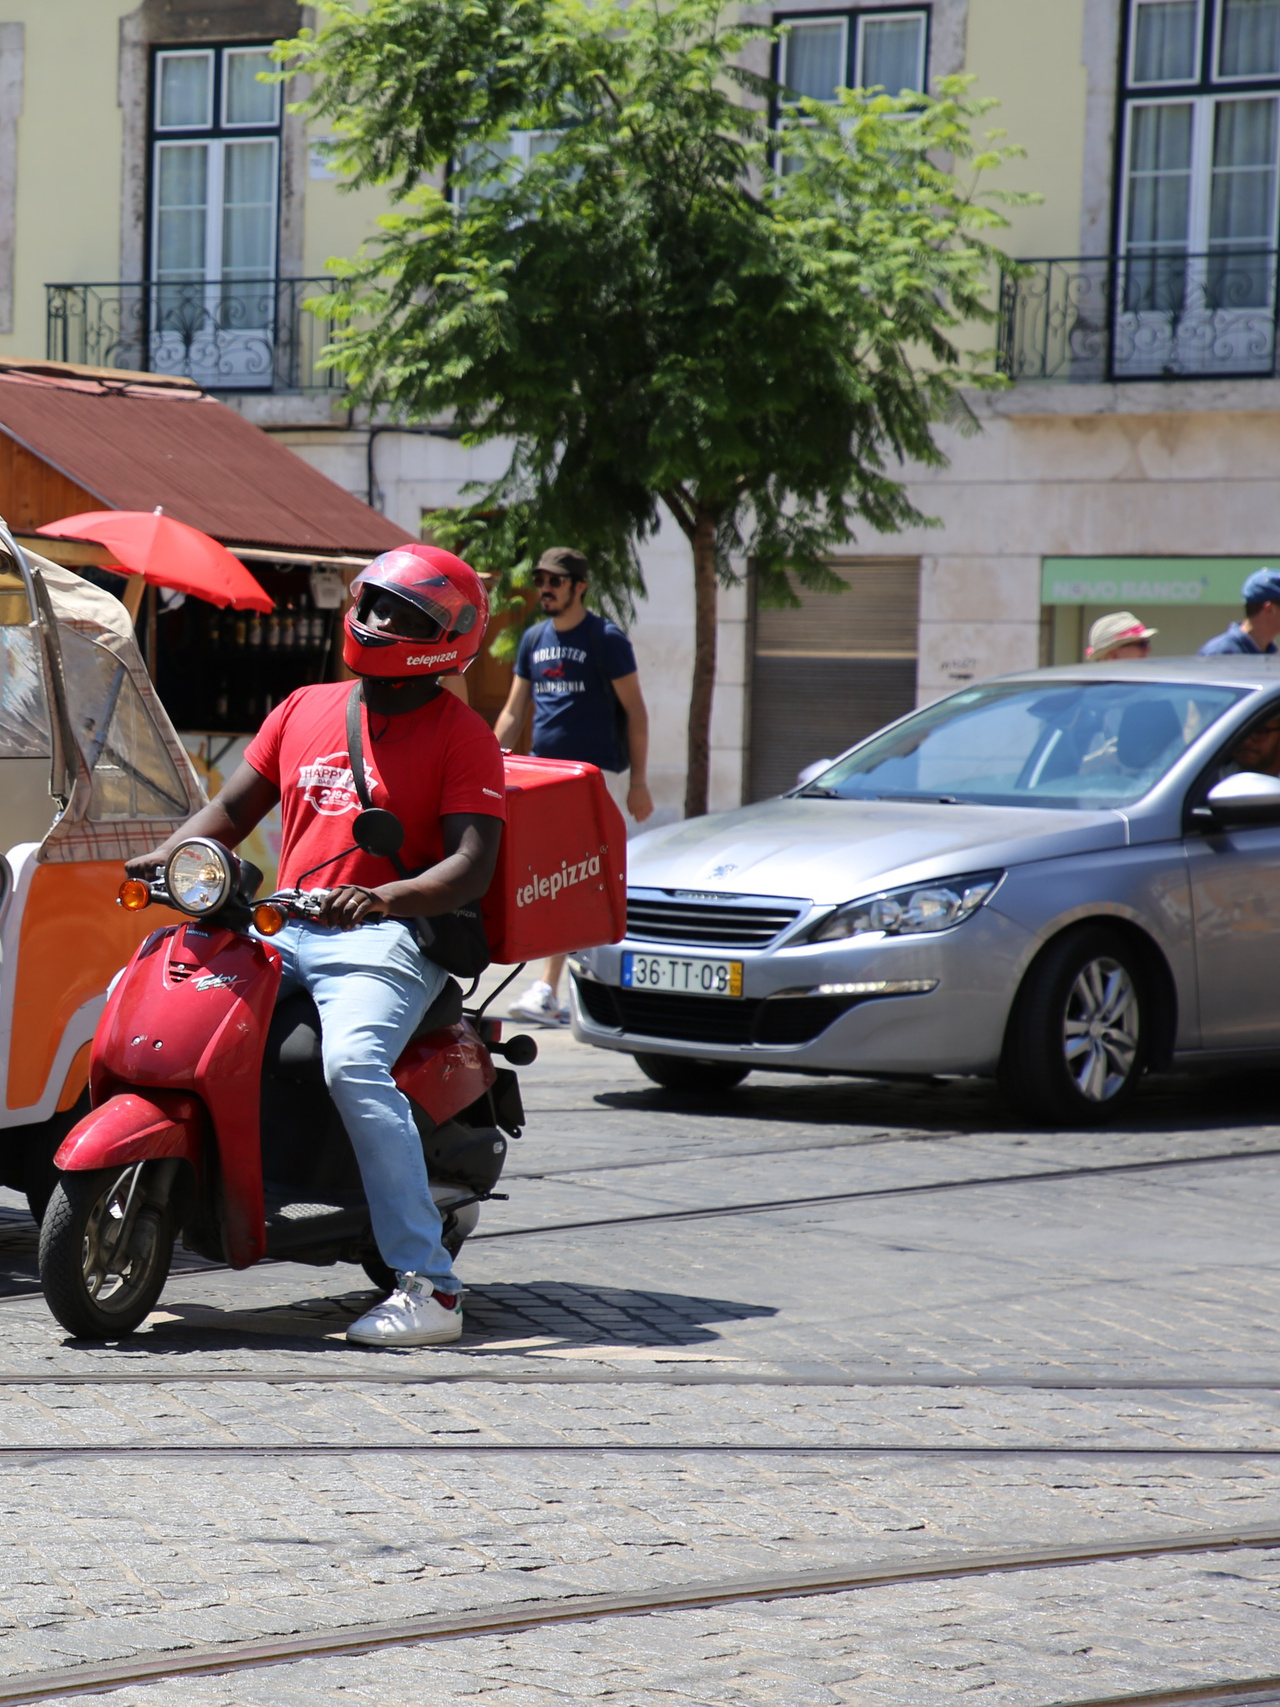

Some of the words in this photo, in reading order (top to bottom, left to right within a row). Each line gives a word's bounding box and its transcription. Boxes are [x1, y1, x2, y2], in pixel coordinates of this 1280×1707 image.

[1052, 580, 1118, 600] NOVO
[1123, 580, 1202, 600] BANCO
[406, 650, 458, 668] telepizza
[532, 645, 587, 664] HOLLISTER
[516, 854, 601, 908] telepizza
